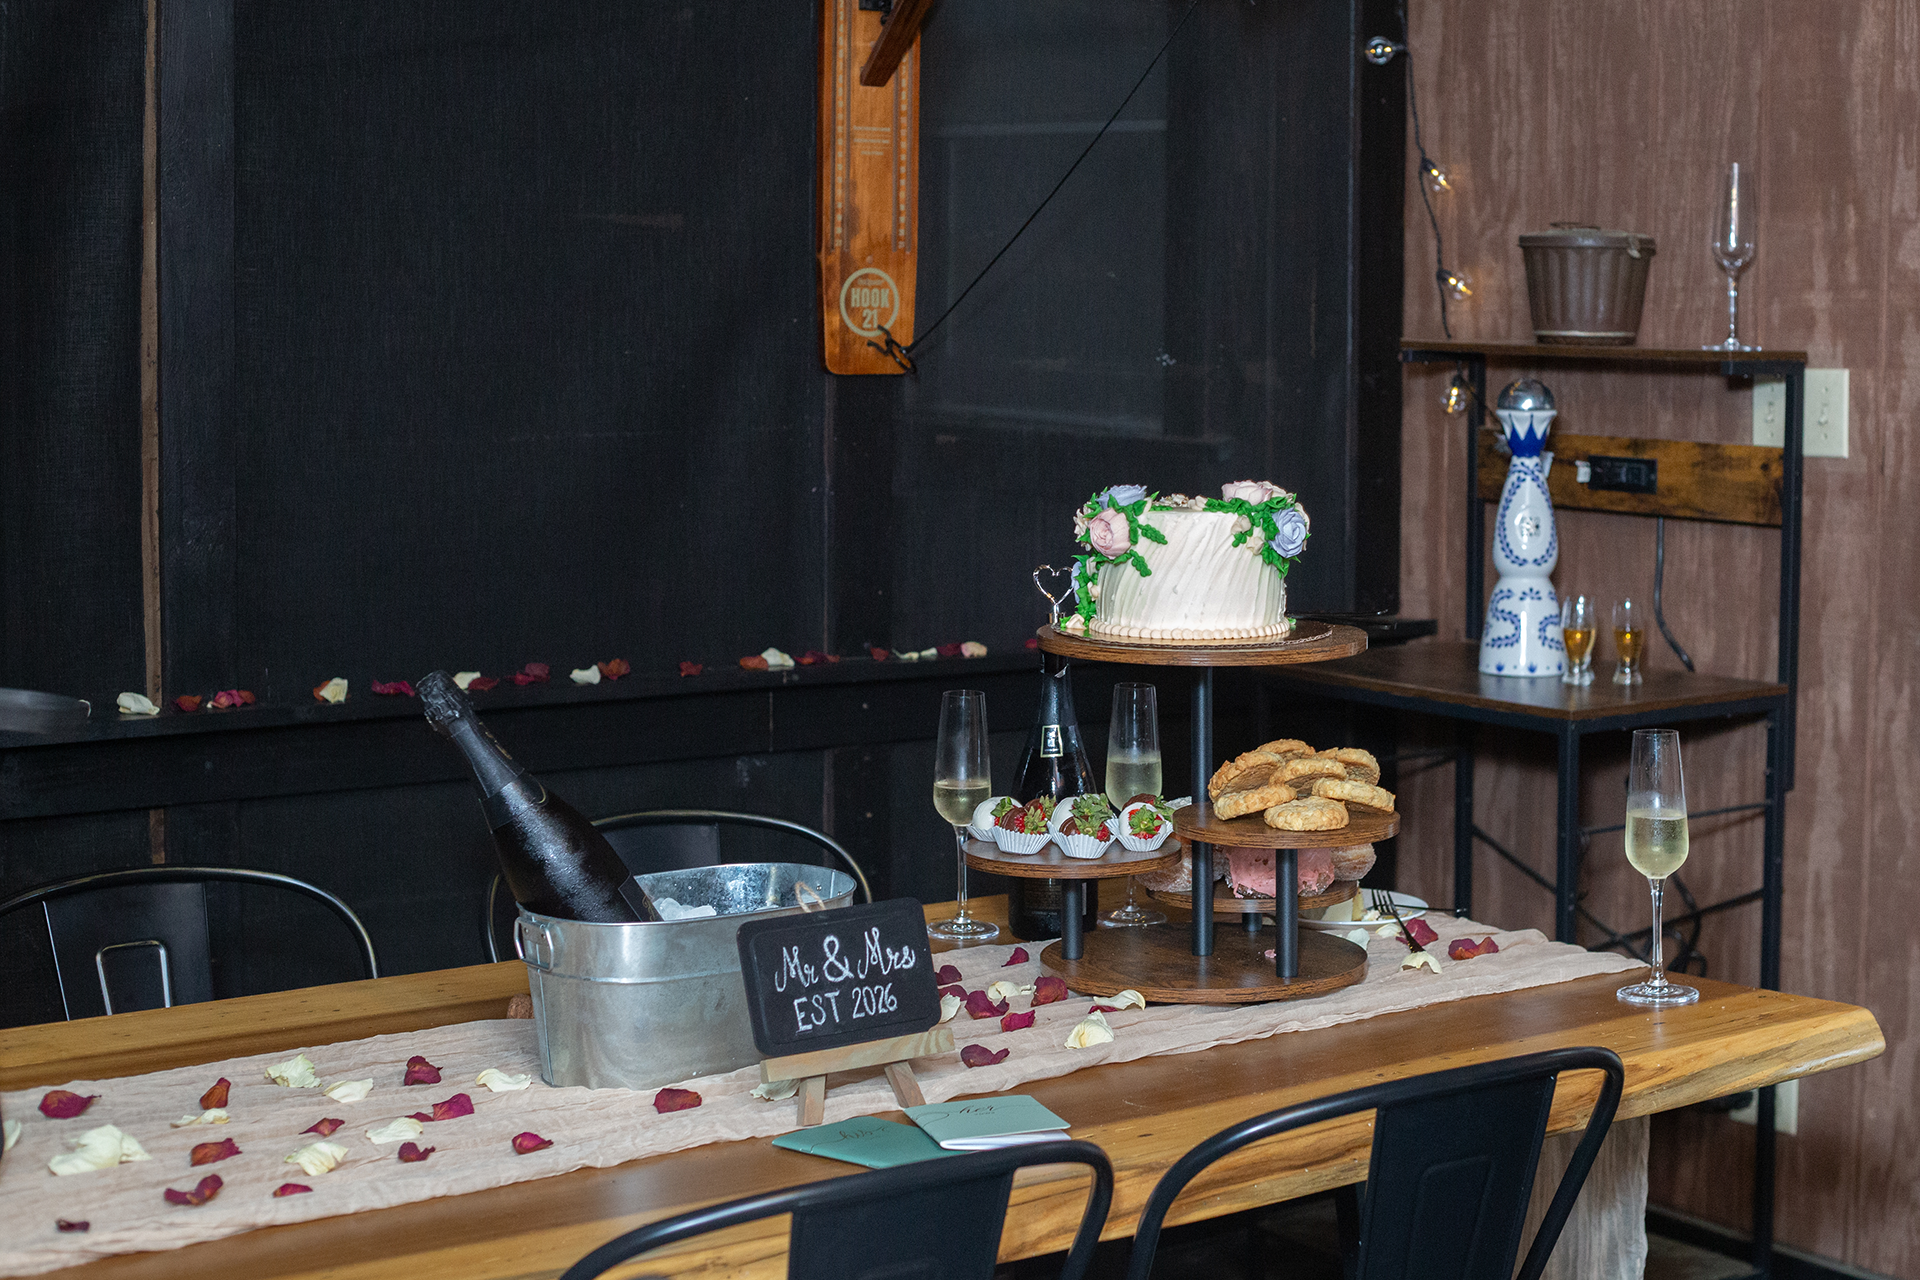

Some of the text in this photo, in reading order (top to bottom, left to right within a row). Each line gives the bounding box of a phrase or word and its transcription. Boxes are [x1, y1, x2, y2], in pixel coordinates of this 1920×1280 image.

[851, 287, 890, 308] HOOK
[862, 308, 878, 329] 21
[774, 926, 917, 993] Mr & Mrs
[793, 983, 898, 1032] EST 2026
